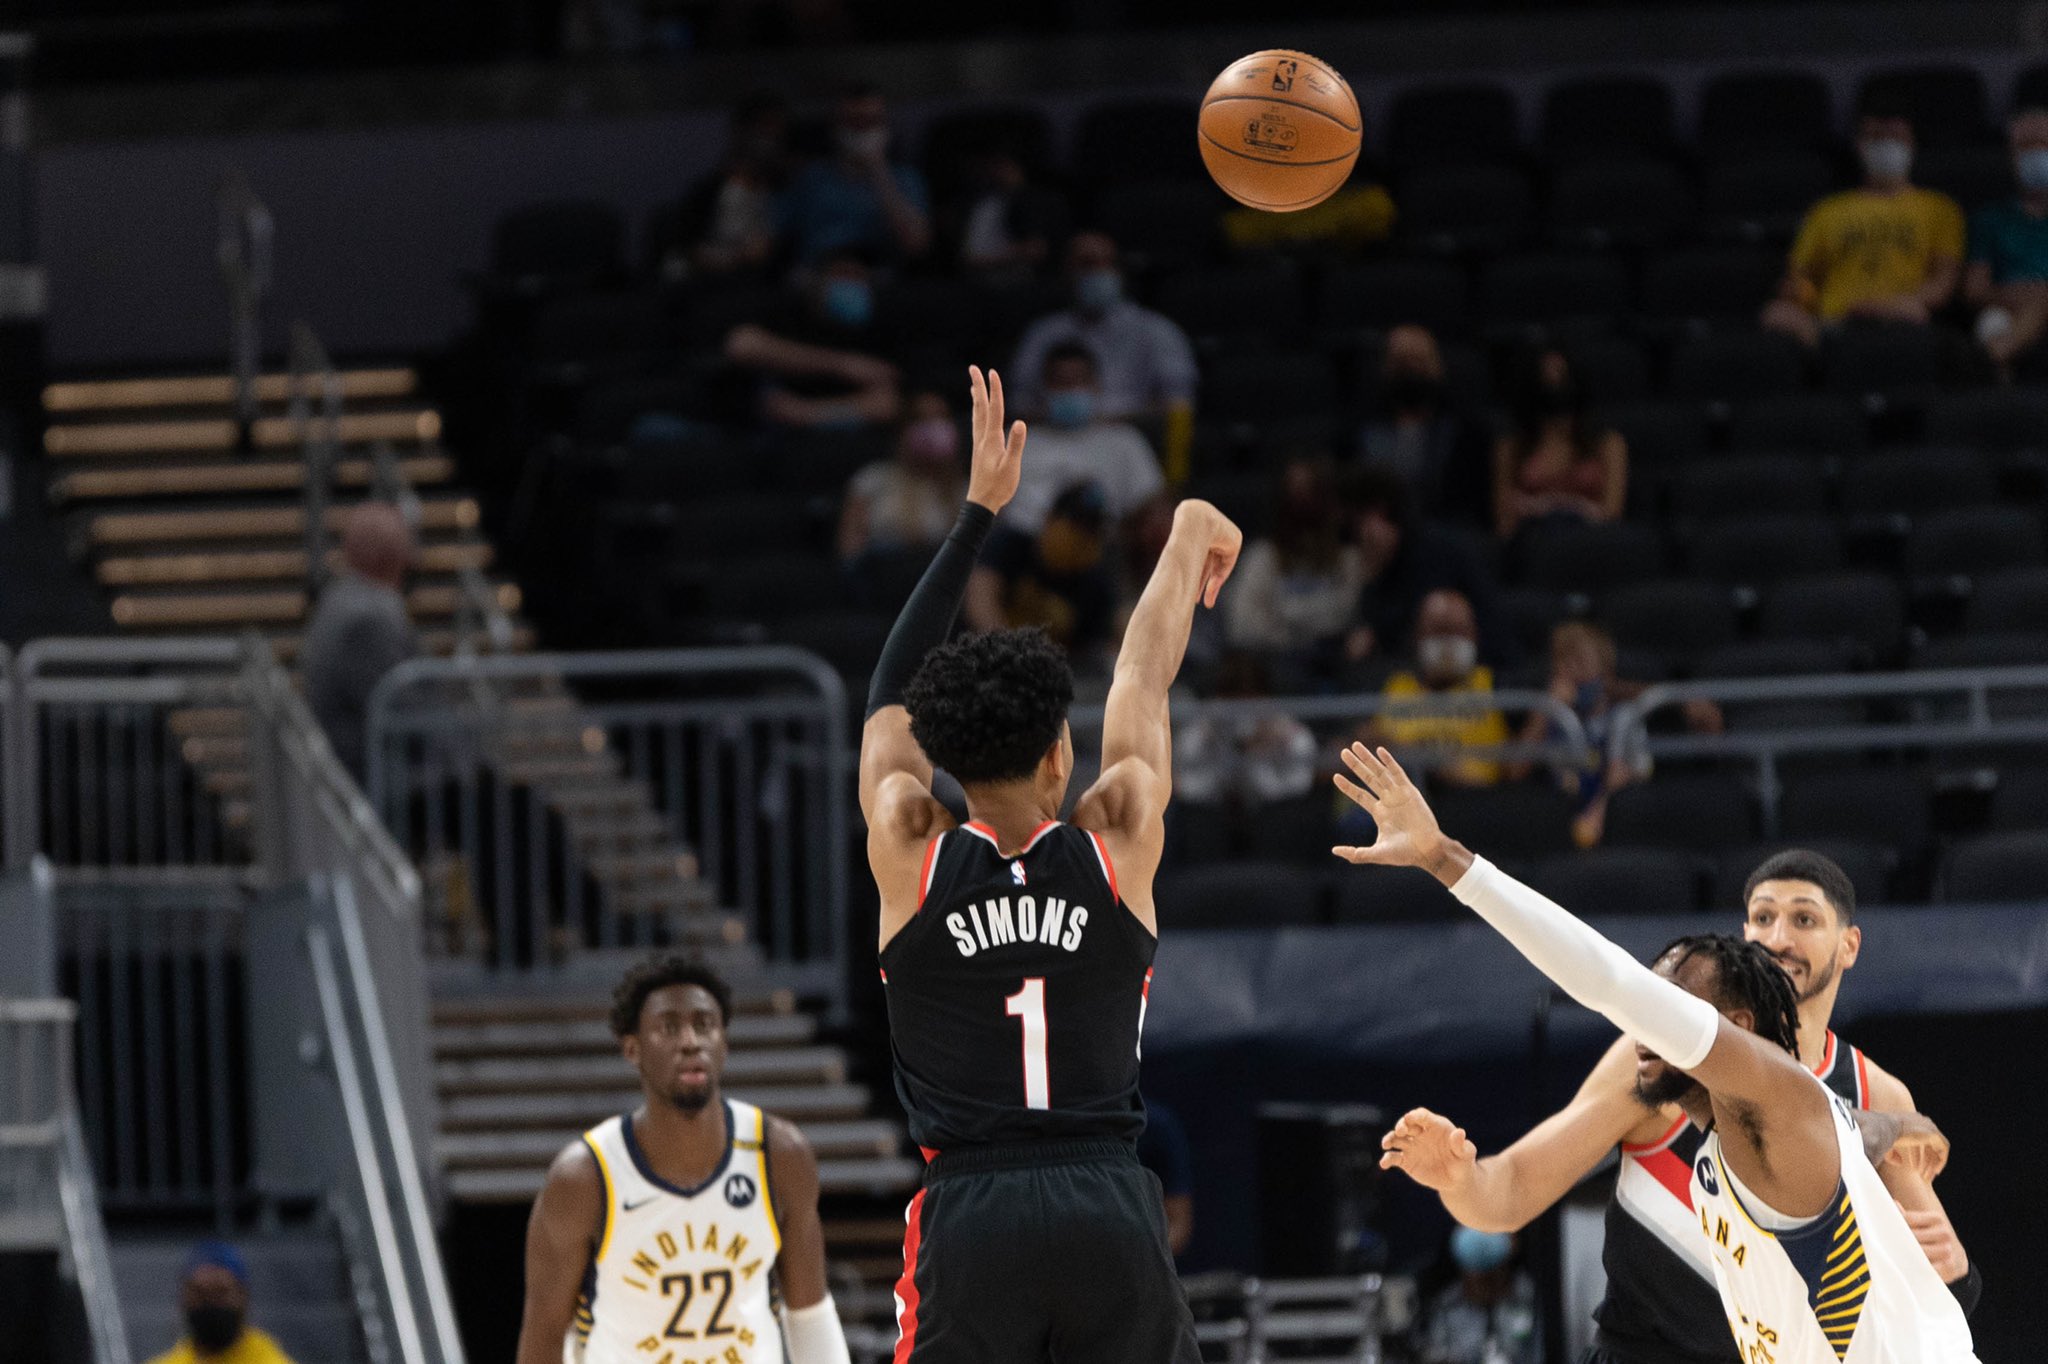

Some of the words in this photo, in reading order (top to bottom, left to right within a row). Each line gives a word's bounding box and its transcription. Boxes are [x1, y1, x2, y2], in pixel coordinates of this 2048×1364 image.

[946, 895, 1088, 957] SIMONS
[1005, 976, 1050, 1110] 1
[623, 1222, 762, 1291] INDIANA
[660, 1268, 736, 1340] 22
